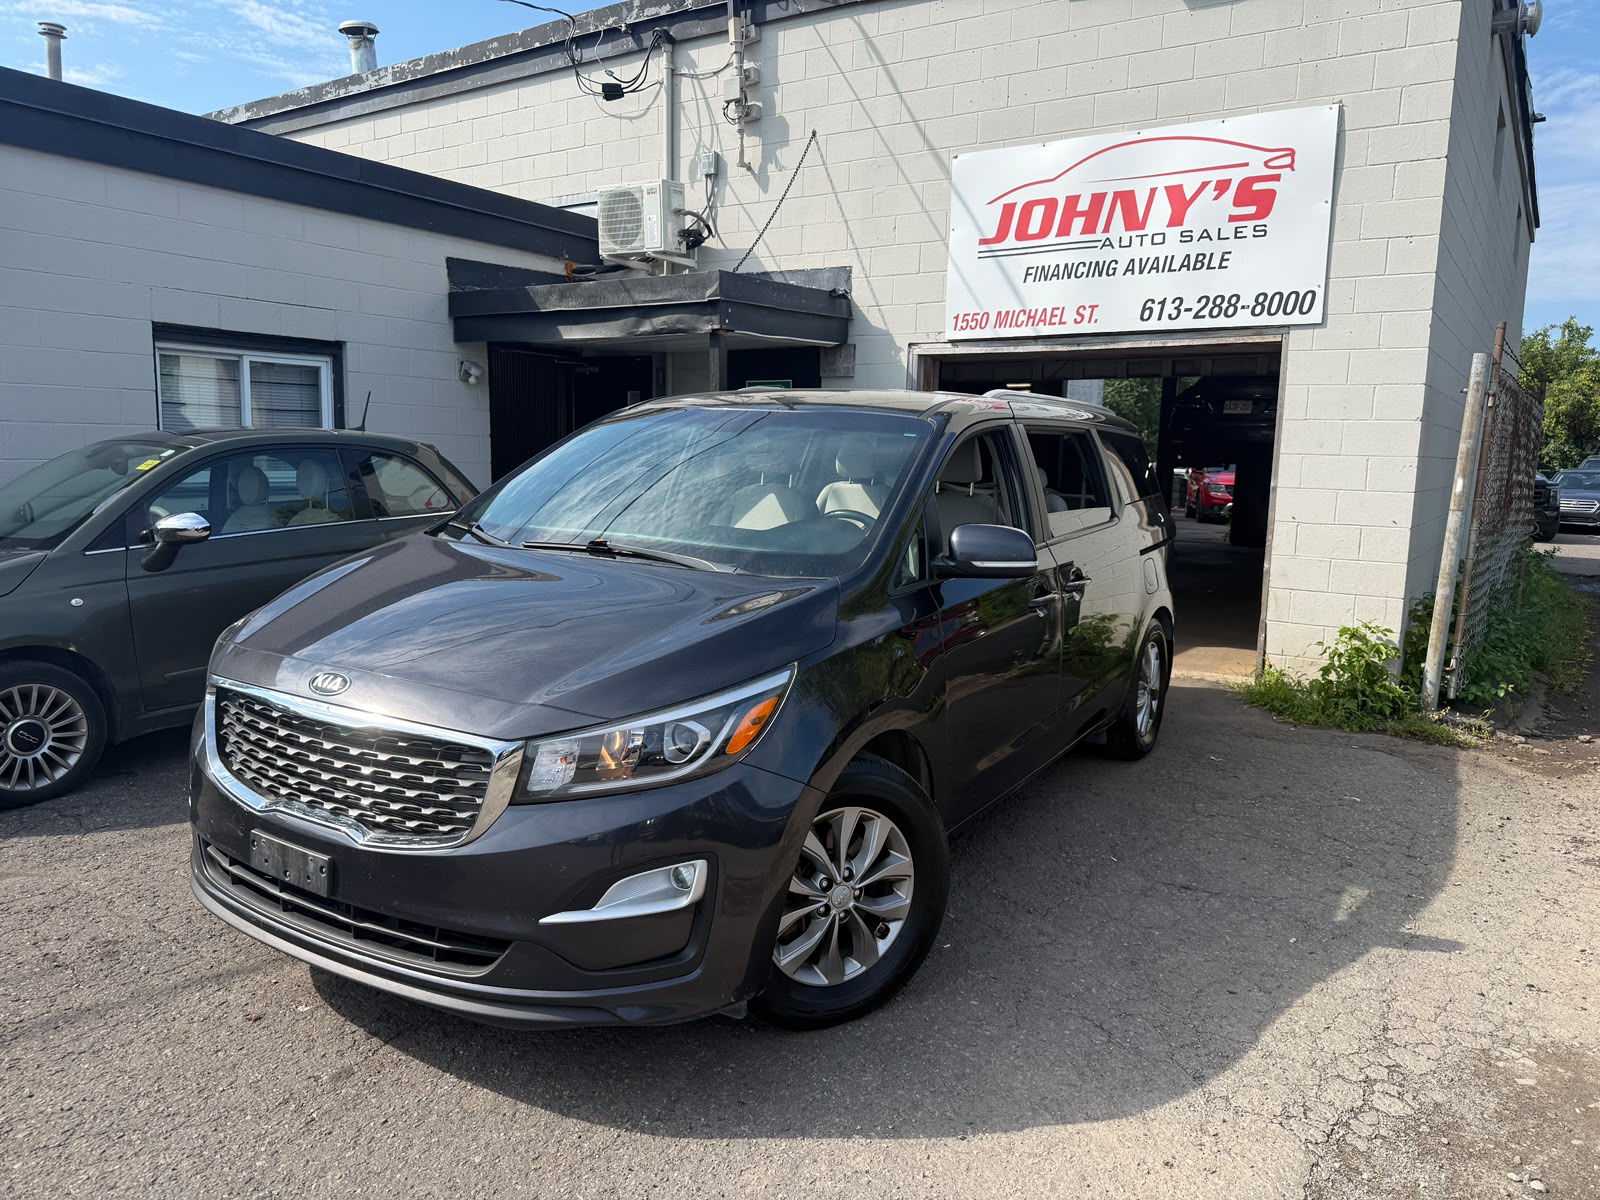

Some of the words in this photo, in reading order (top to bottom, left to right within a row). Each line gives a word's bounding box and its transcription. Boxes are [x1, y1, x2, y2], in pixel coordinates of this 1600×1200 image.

[978, 173, 1282, 246] JOHNY'S
[1099, 231, 1167, 250] AUTO
[1179, 223, 1268, 243] SALES
[1022, 258, 1119, 284] FINANCING
[1122, 250, 1232, 276] AVAILABLE
[952, 311, 990, 332] 1550
[993, 305, 1068, 330] MICHAEL
[1072, 304, 1099, 326] ST.
[1139, 289, 1317, 322] 613-288-8000
[312, 673, 344, 691] KIA
